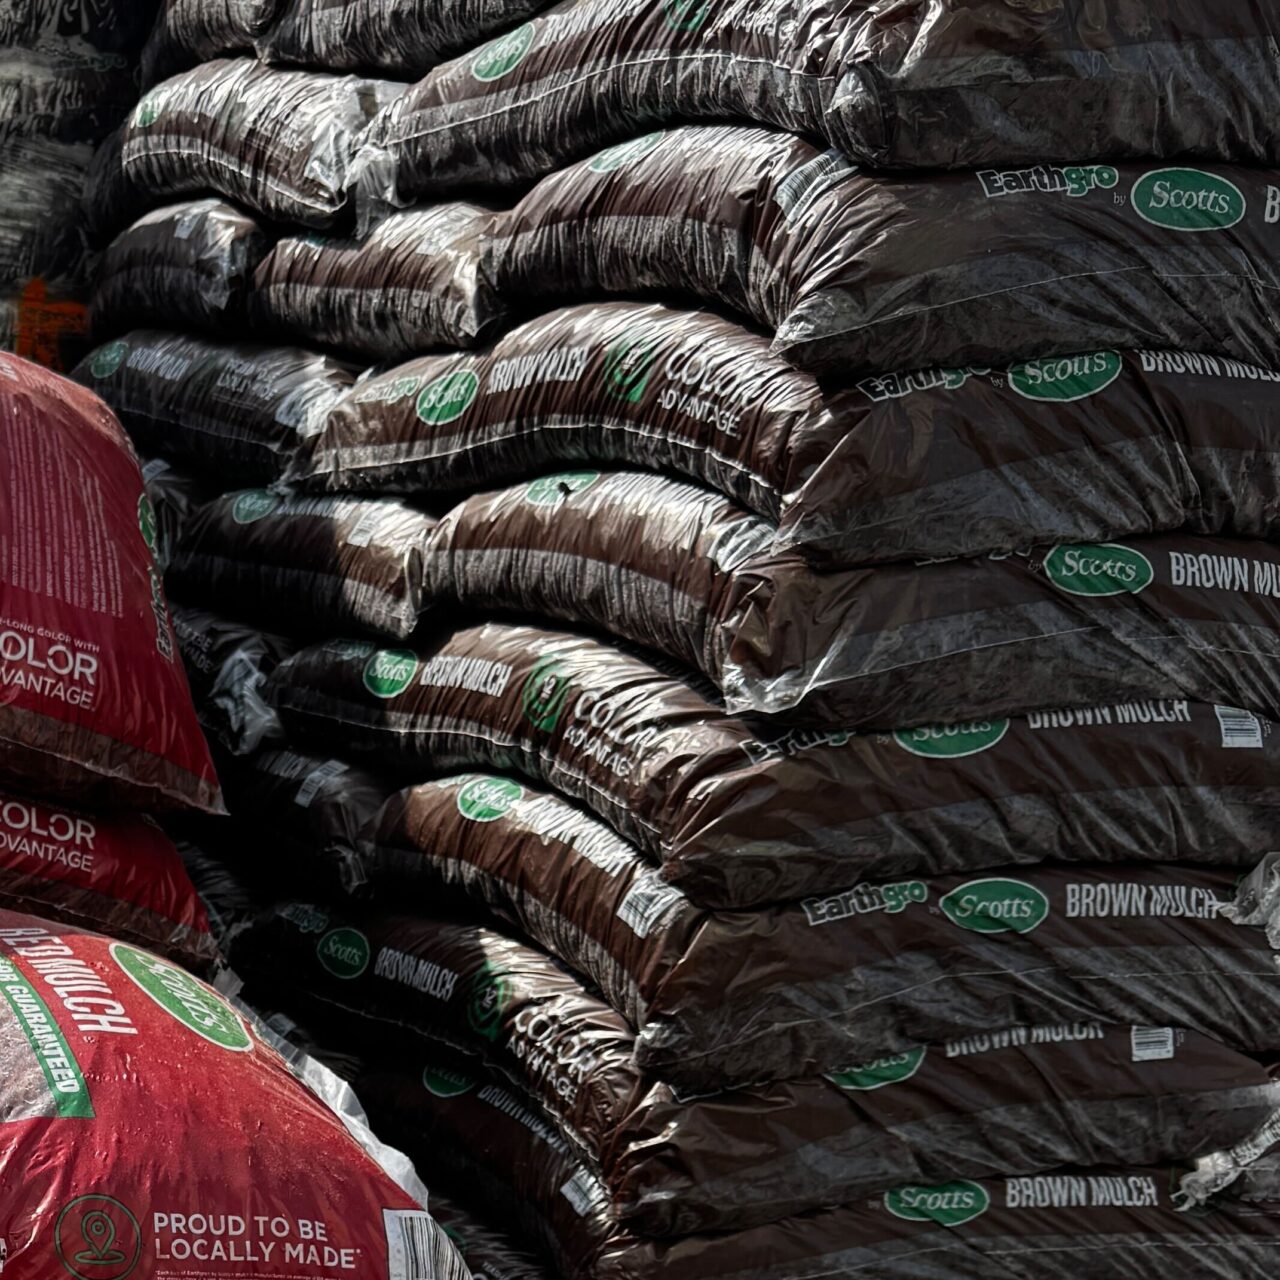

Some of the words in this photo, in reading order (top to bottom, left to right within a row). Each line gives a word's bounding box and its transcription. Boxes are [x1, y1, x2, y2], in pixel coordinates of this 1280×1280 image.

[975, 165, 1119, 197] Earthgro
[1149, 181, 1231, 214] Scotts
[1025, 353, 1111, 385] Scotts
[1169, 551, 1250, 594] BROWN
[803, 881, 928, 925] Earthgro
[954, 894, 1035, 919] Scotts
[1065, 883, 1147, 919] BROWN
[27, 957, 139, 1035] MULCH
[4, 984, 81, 1094] GUARANTEED
[899, 1186, 975, 1211] Scotts
[1006, 1177, 1087, 1208] BROWN
[153, 1212, 245, 1237] PROUD
[253, 1215, 290, 1237] TO
[297, 1219, 328, 1242] BE
[155, 1238, 272, 1262] LOCALLY
